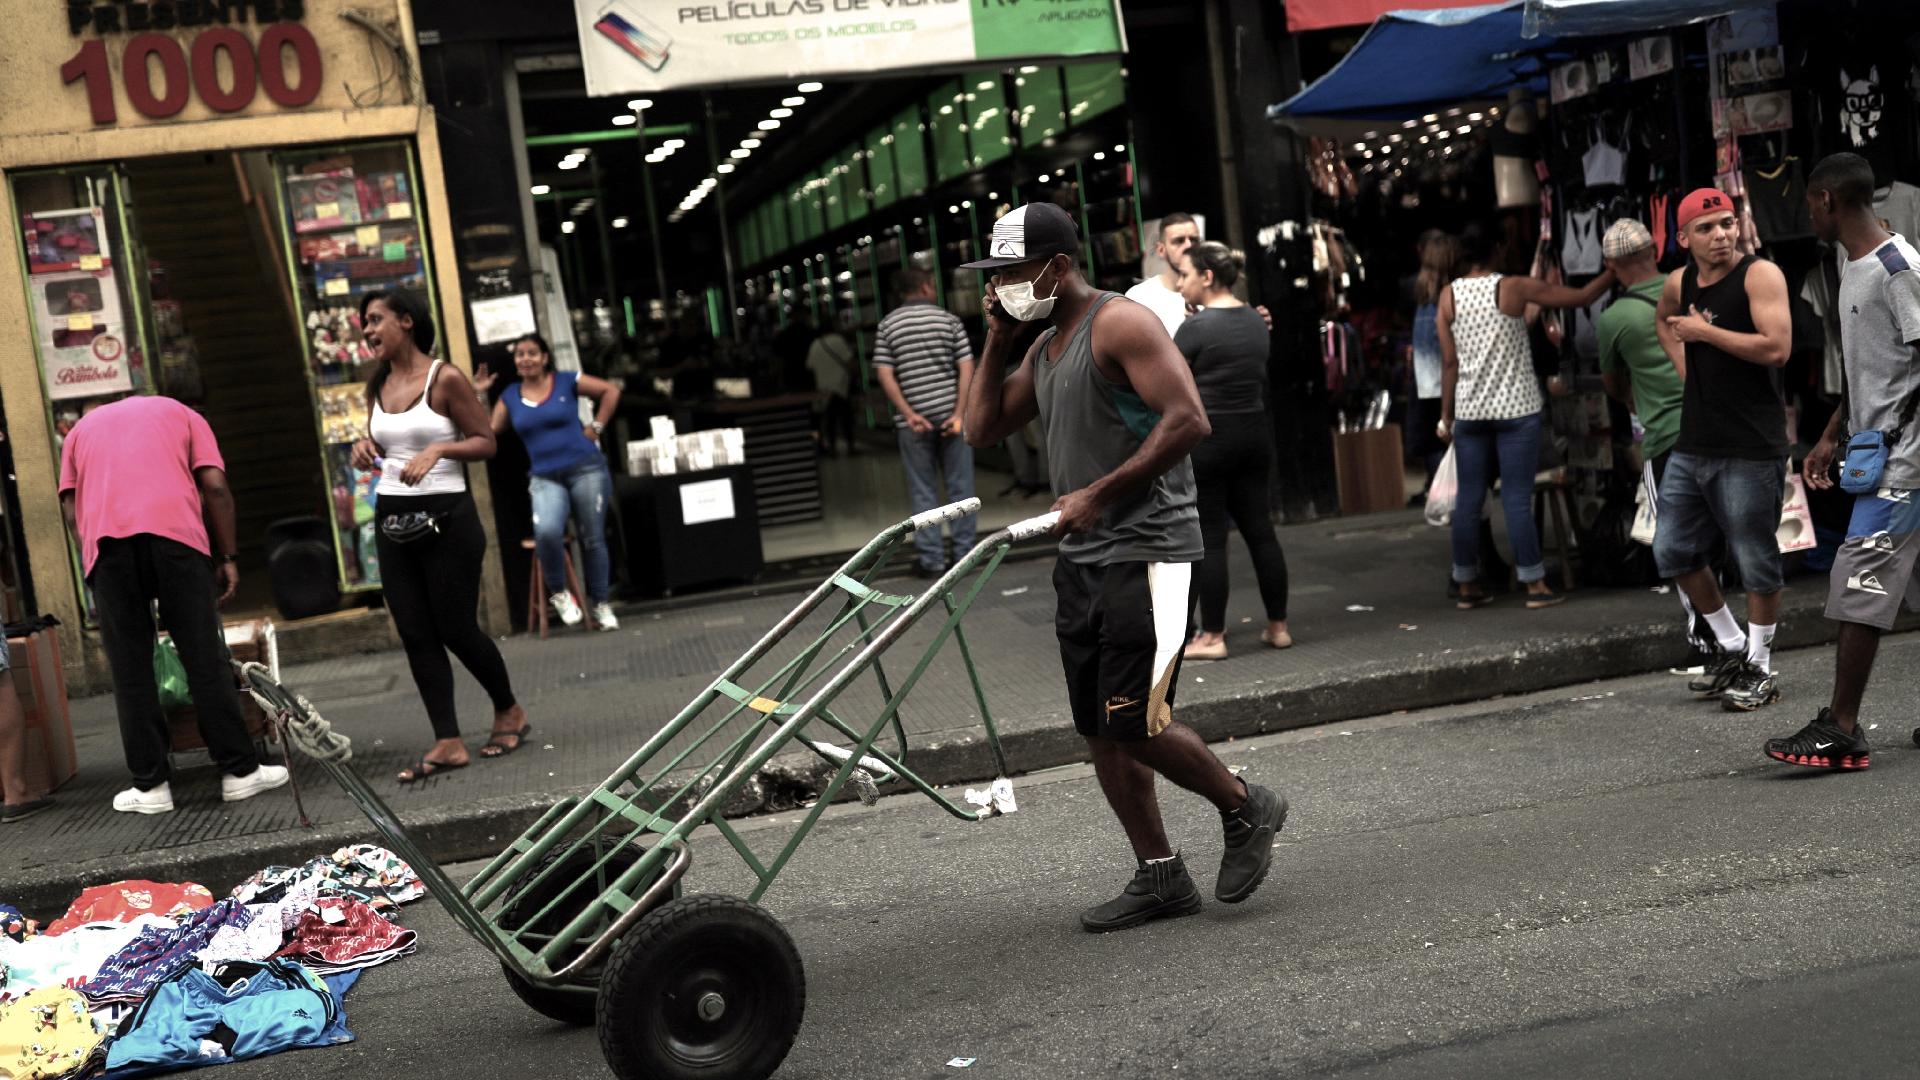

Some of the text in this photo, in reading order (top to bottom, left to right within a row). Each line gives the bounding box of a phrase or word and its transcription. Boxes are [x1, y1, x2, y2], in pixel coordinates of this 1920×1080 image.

[67, 0, 304, 35] PRESENTES
[678, 0, 825, 23] PELÍCULAS
[724, 19, 917, 45] TODOS OS MODELOS
[60, 22, 323, 125] 1000
